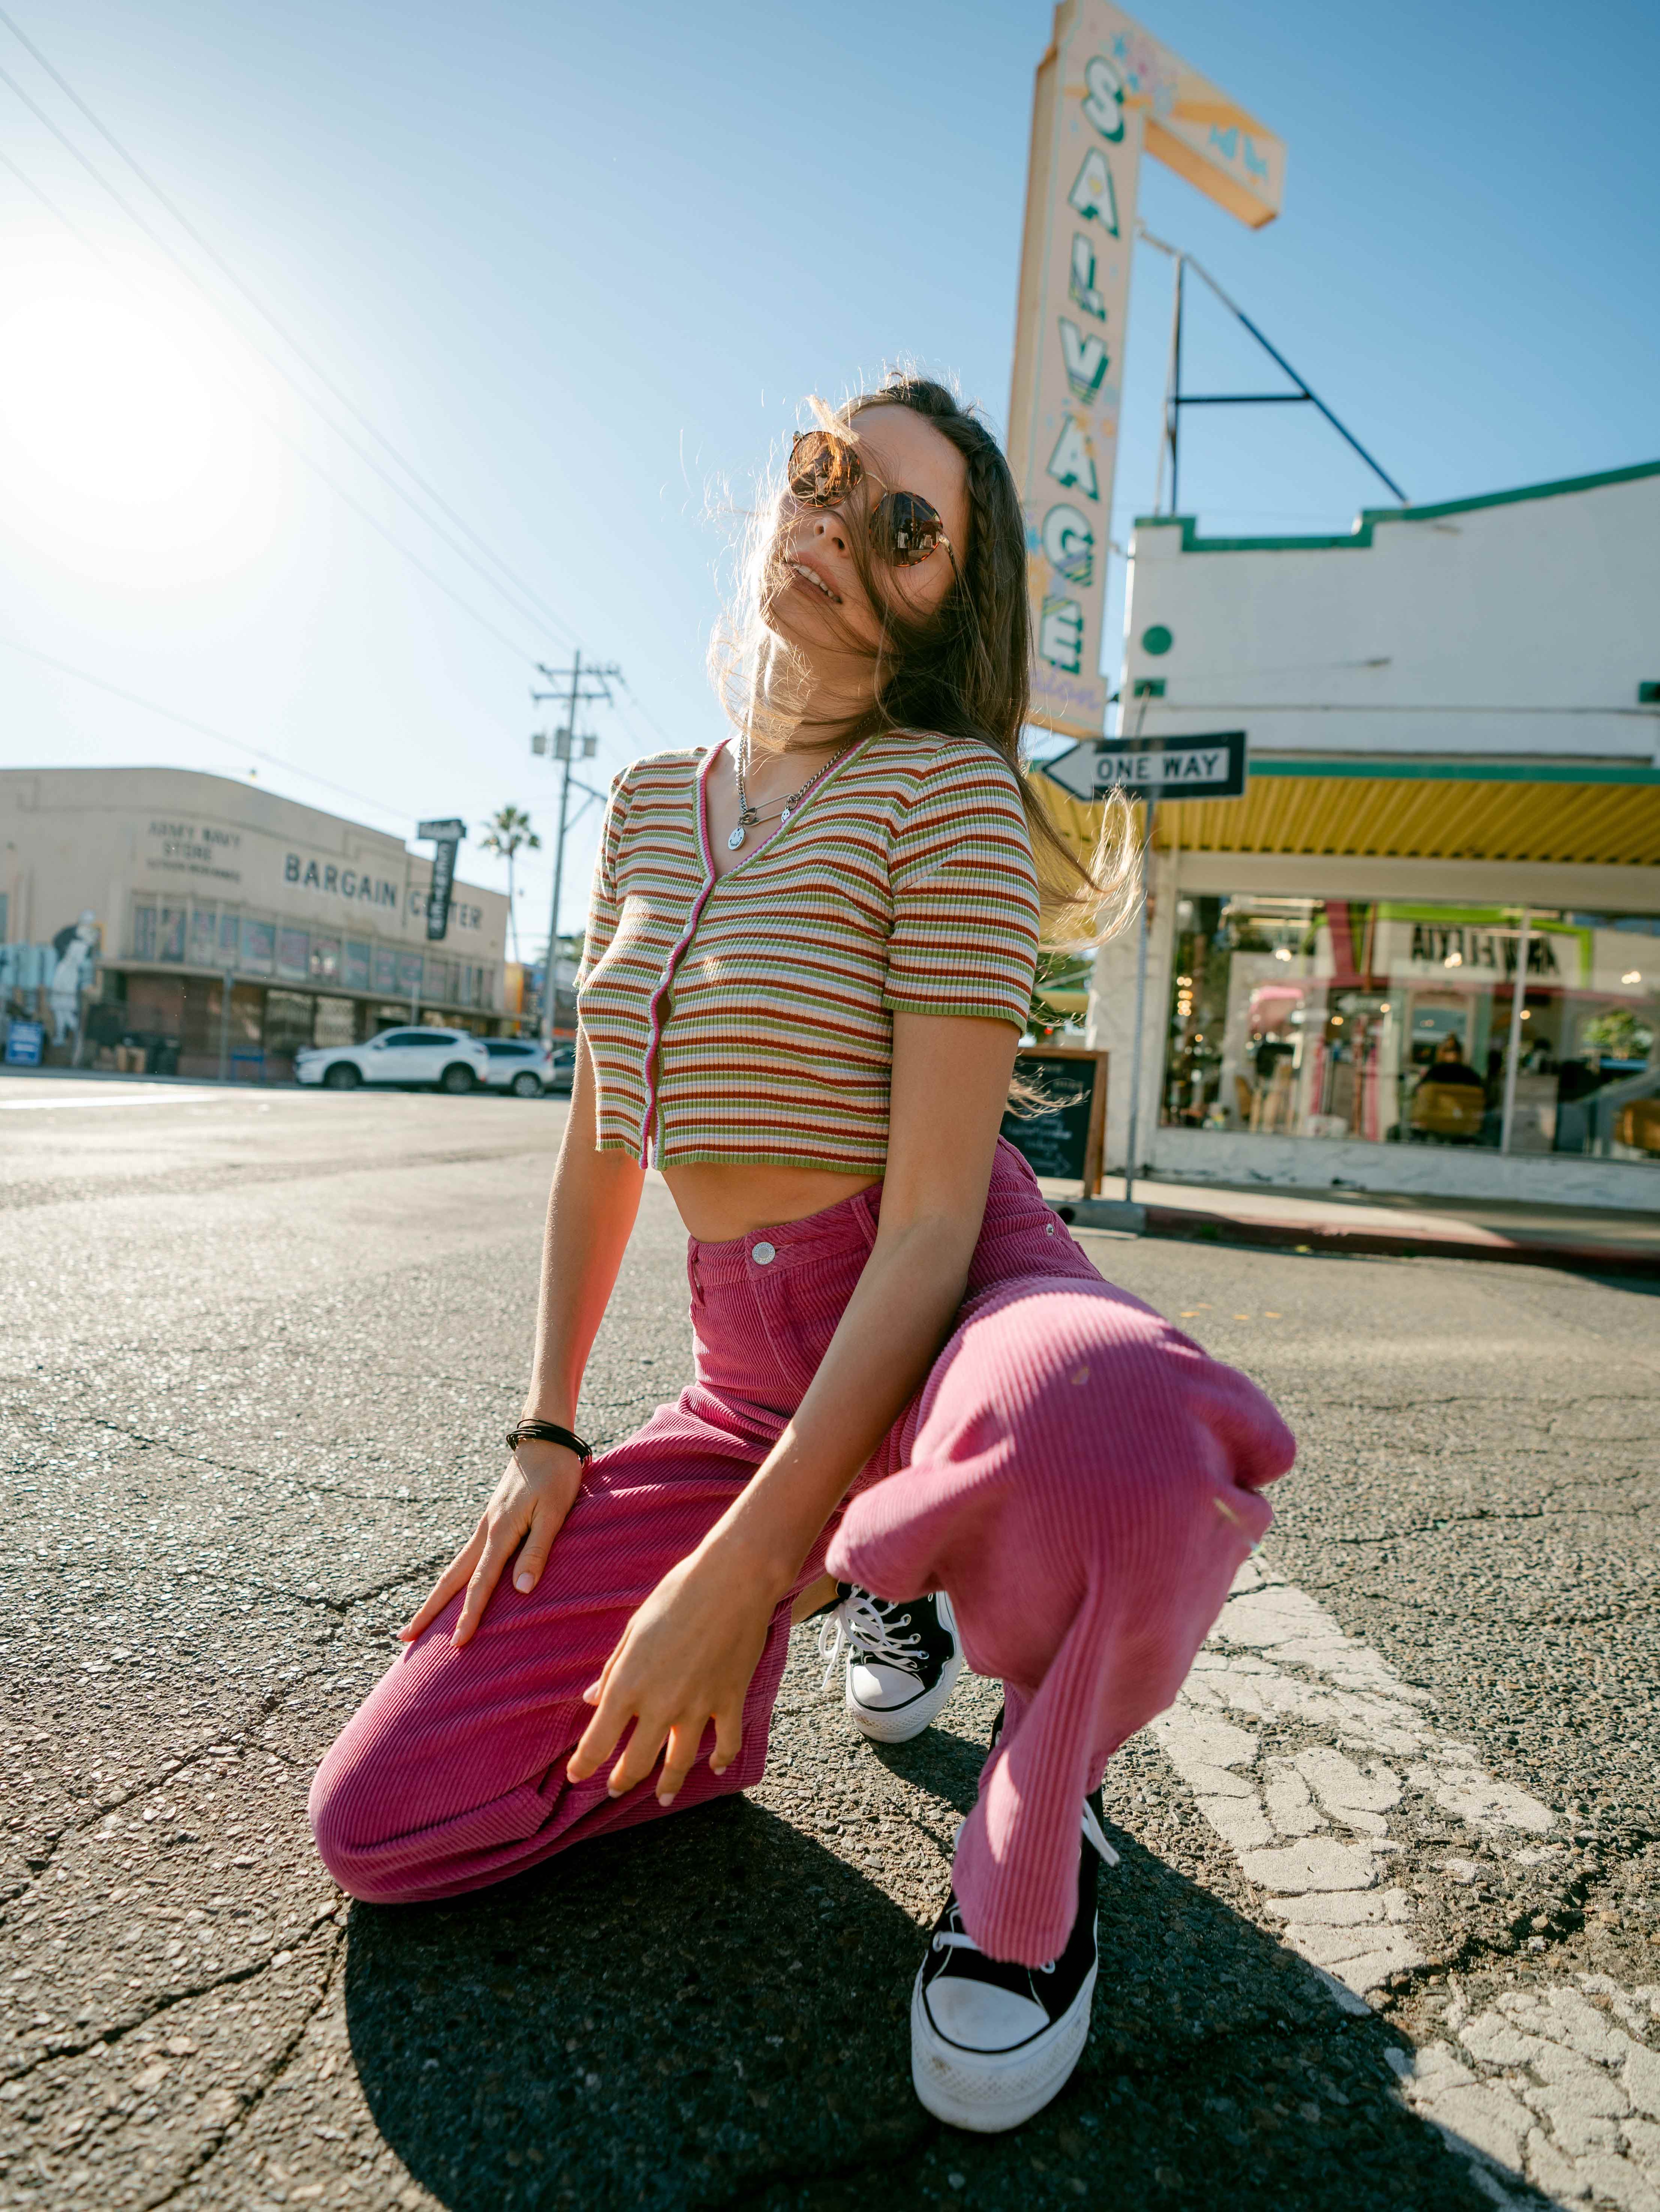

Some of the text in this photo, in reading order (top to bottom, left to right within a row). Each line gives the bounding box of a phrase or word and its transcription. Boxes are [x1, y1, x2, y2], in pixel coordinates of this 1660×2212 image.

[1039, 55, 1125, 674] SALVAGE
[1097, 753, 1220, 780] ONE WAY
[284, 853, 397, 907] BARGAIN
[409, 890, 482, 929] CTER
